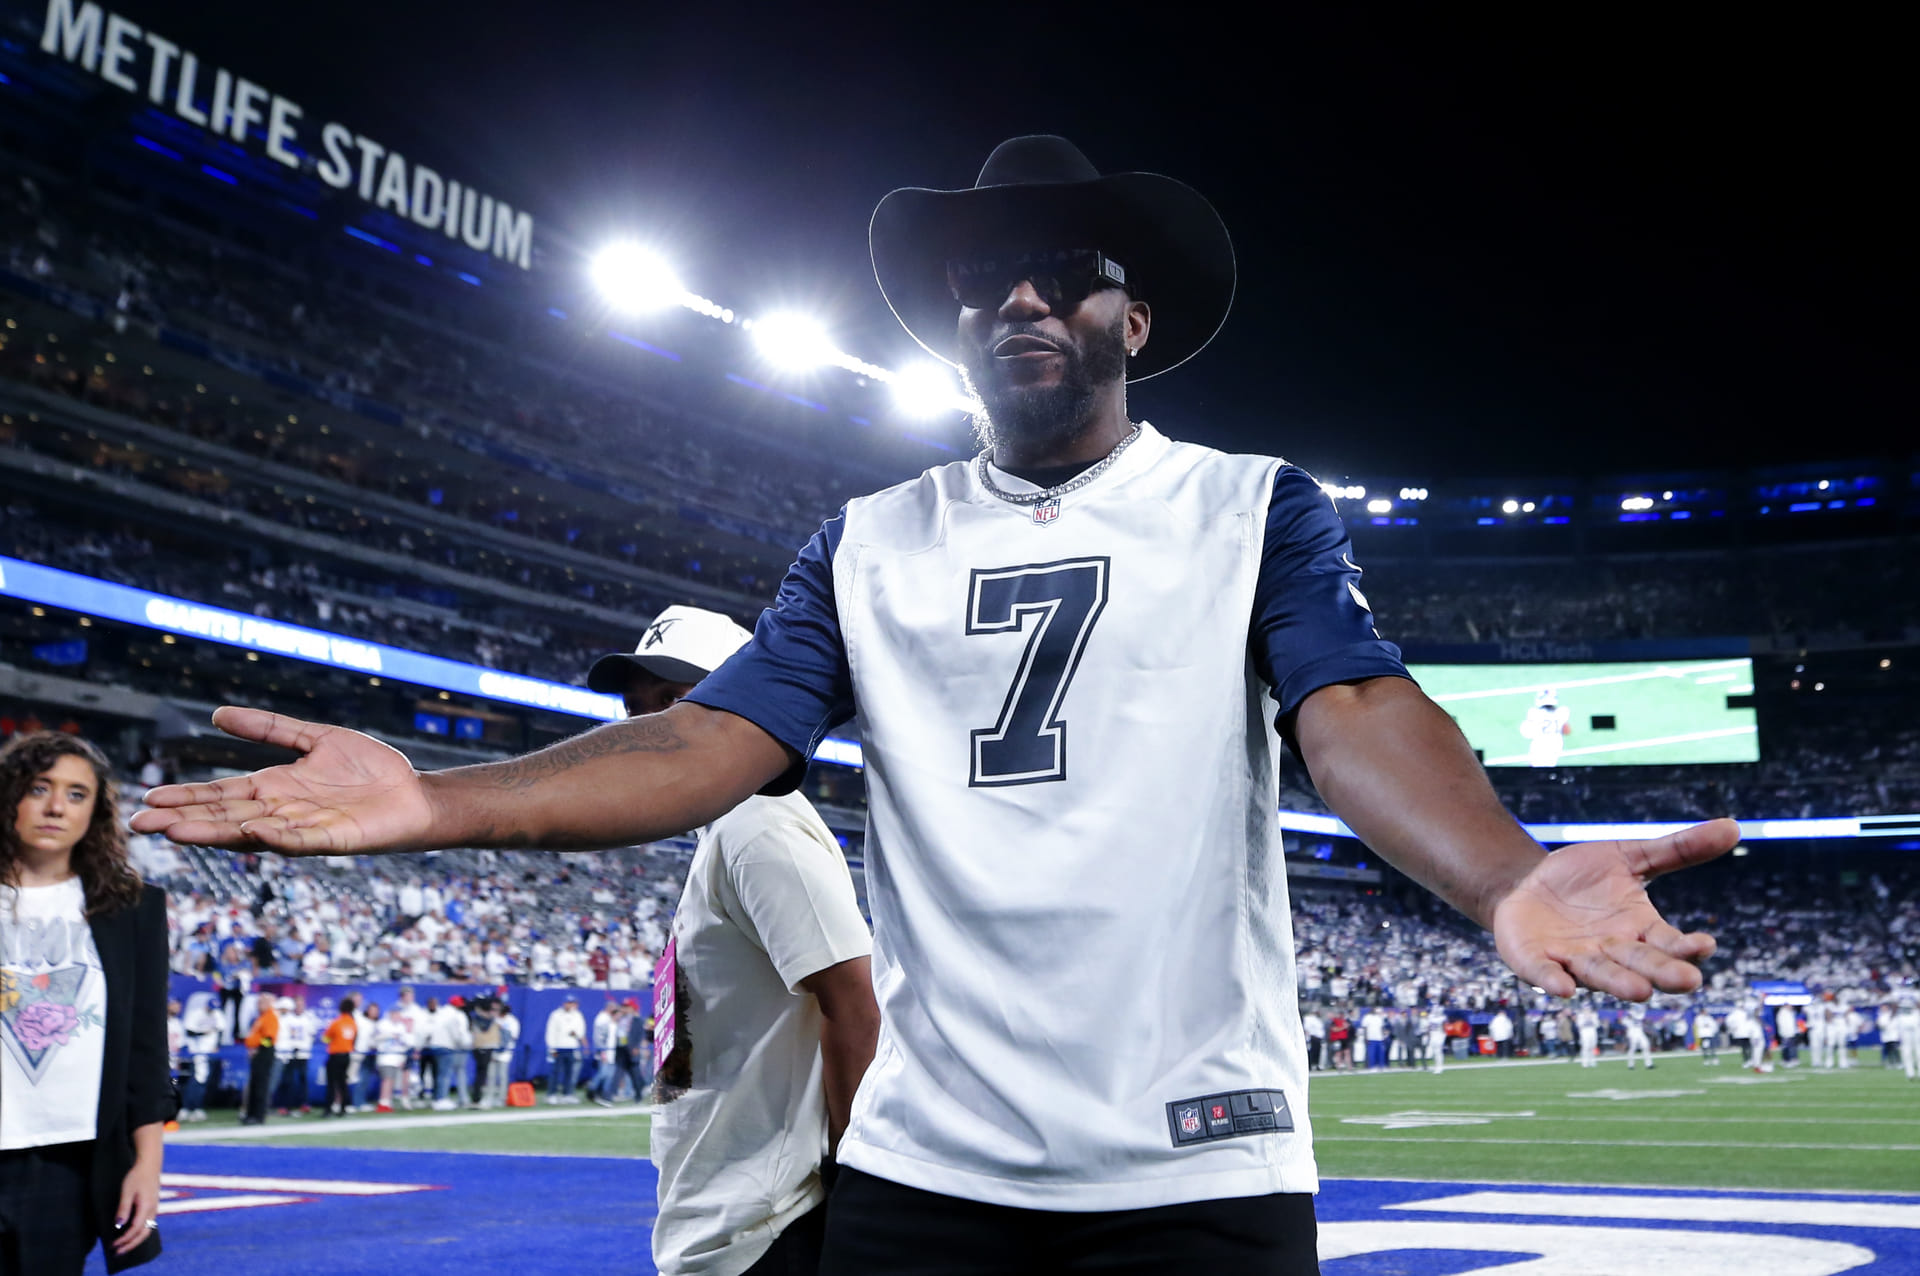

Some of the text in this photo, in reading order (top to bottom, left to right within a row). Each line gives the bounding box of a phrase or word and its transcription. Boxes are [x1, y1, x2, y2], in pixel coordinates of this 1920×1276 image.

[41, 0, 534, 270] METLIFE STADIUM
[1035, 506, 1057, 520] NFL
[1501, 642, 1592, 659] HCLTech
[965, 556, 1110, 787] 7
[1183, 1118, 1199, 1130] NFL
